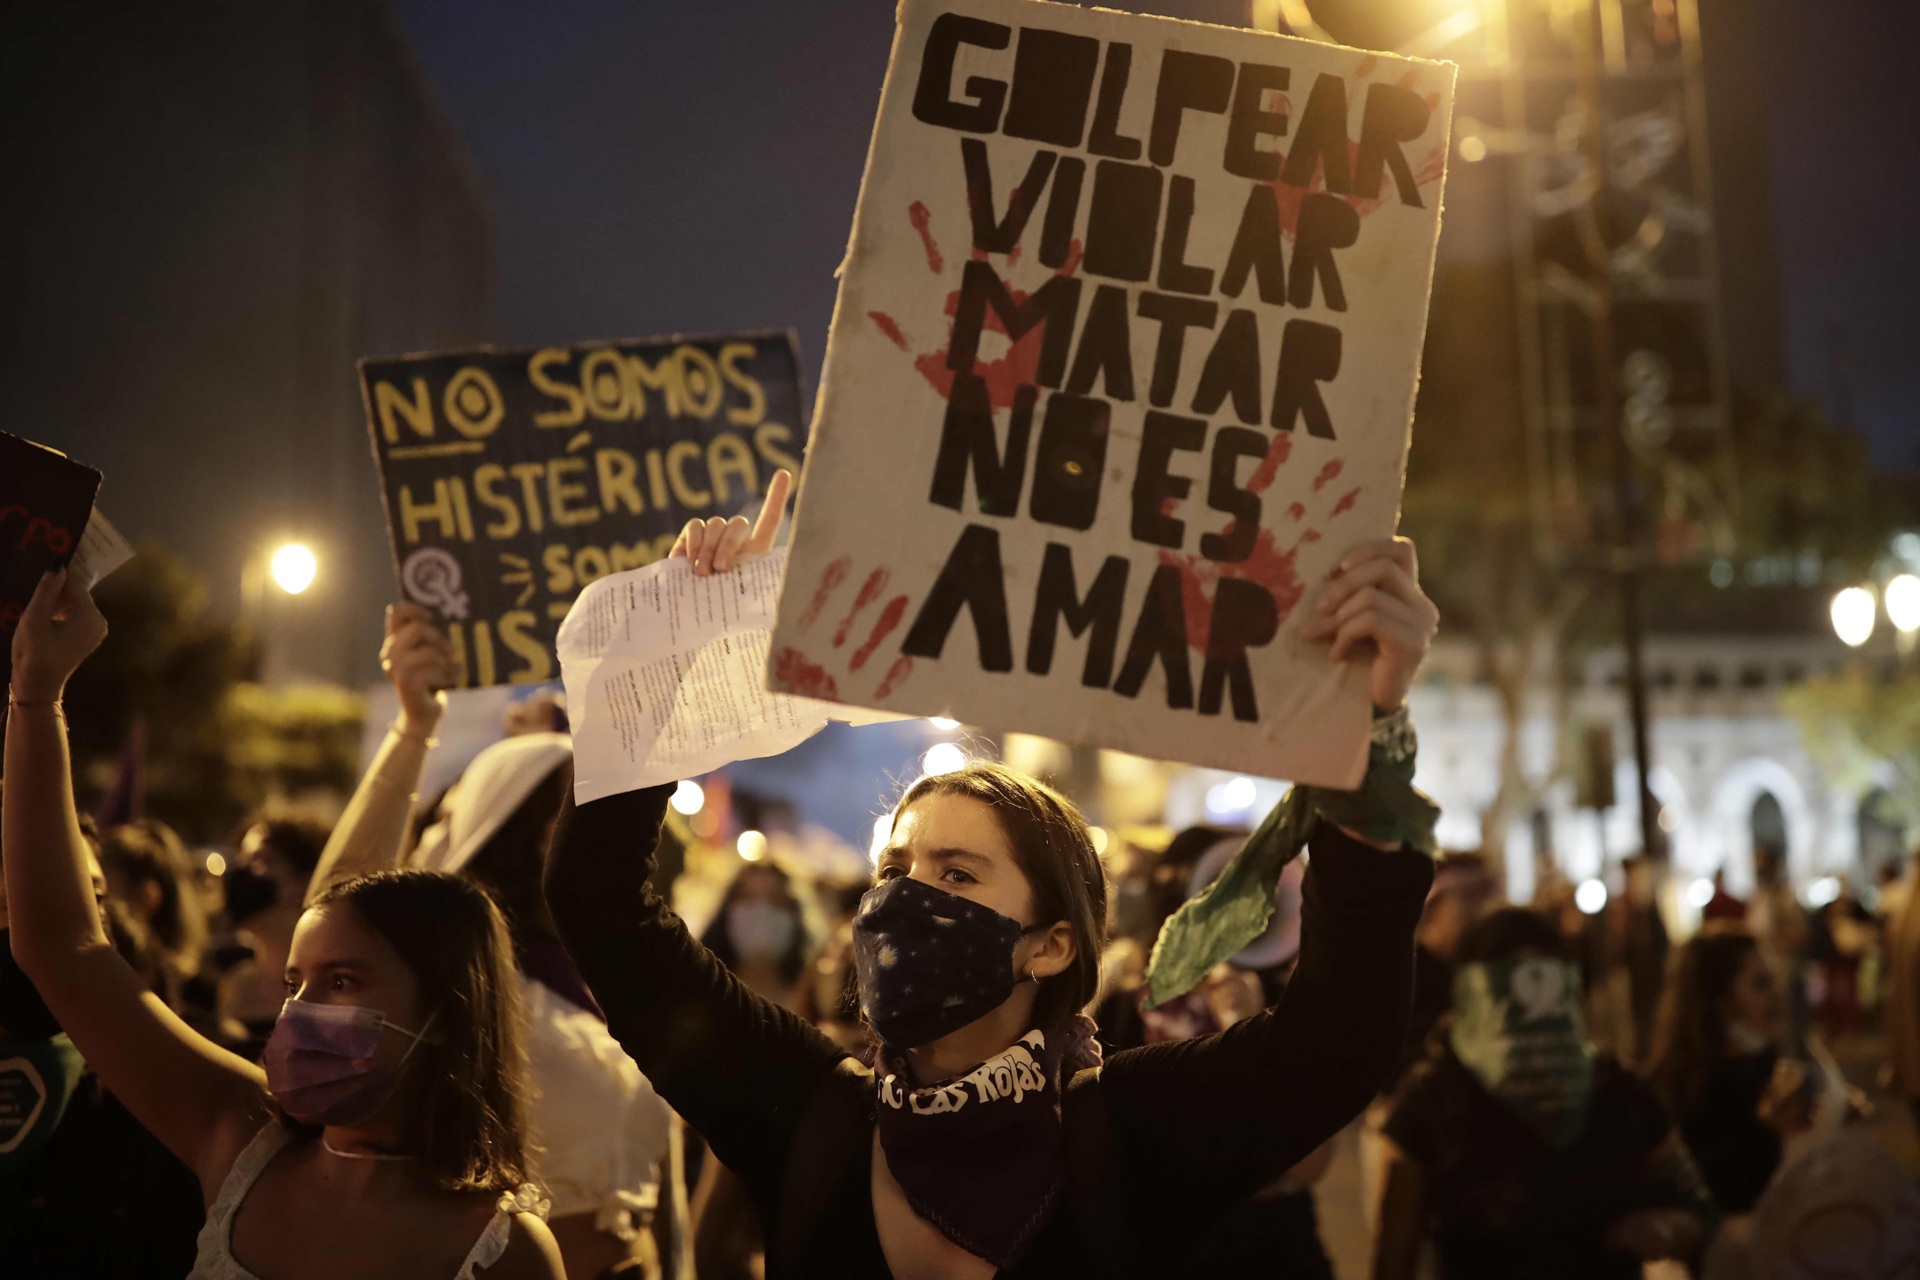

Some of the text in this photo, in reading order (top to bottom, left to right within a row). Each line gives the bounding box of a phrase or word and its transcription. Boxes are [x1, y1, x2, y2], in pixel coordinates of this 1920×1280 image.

[911, 11, 1432, 209] GOLPEAR
[960, 137, 1360, 312] VIOLAR
[374, 342, 766, 444] NO SOMOS
[945, 259, 1342, 441] MATAR
[400, 422, 801, 543] HISTÉRICAS
[929, 371, 1270, 564] NO ES
[900, 522, 1279, 723] AMAR
